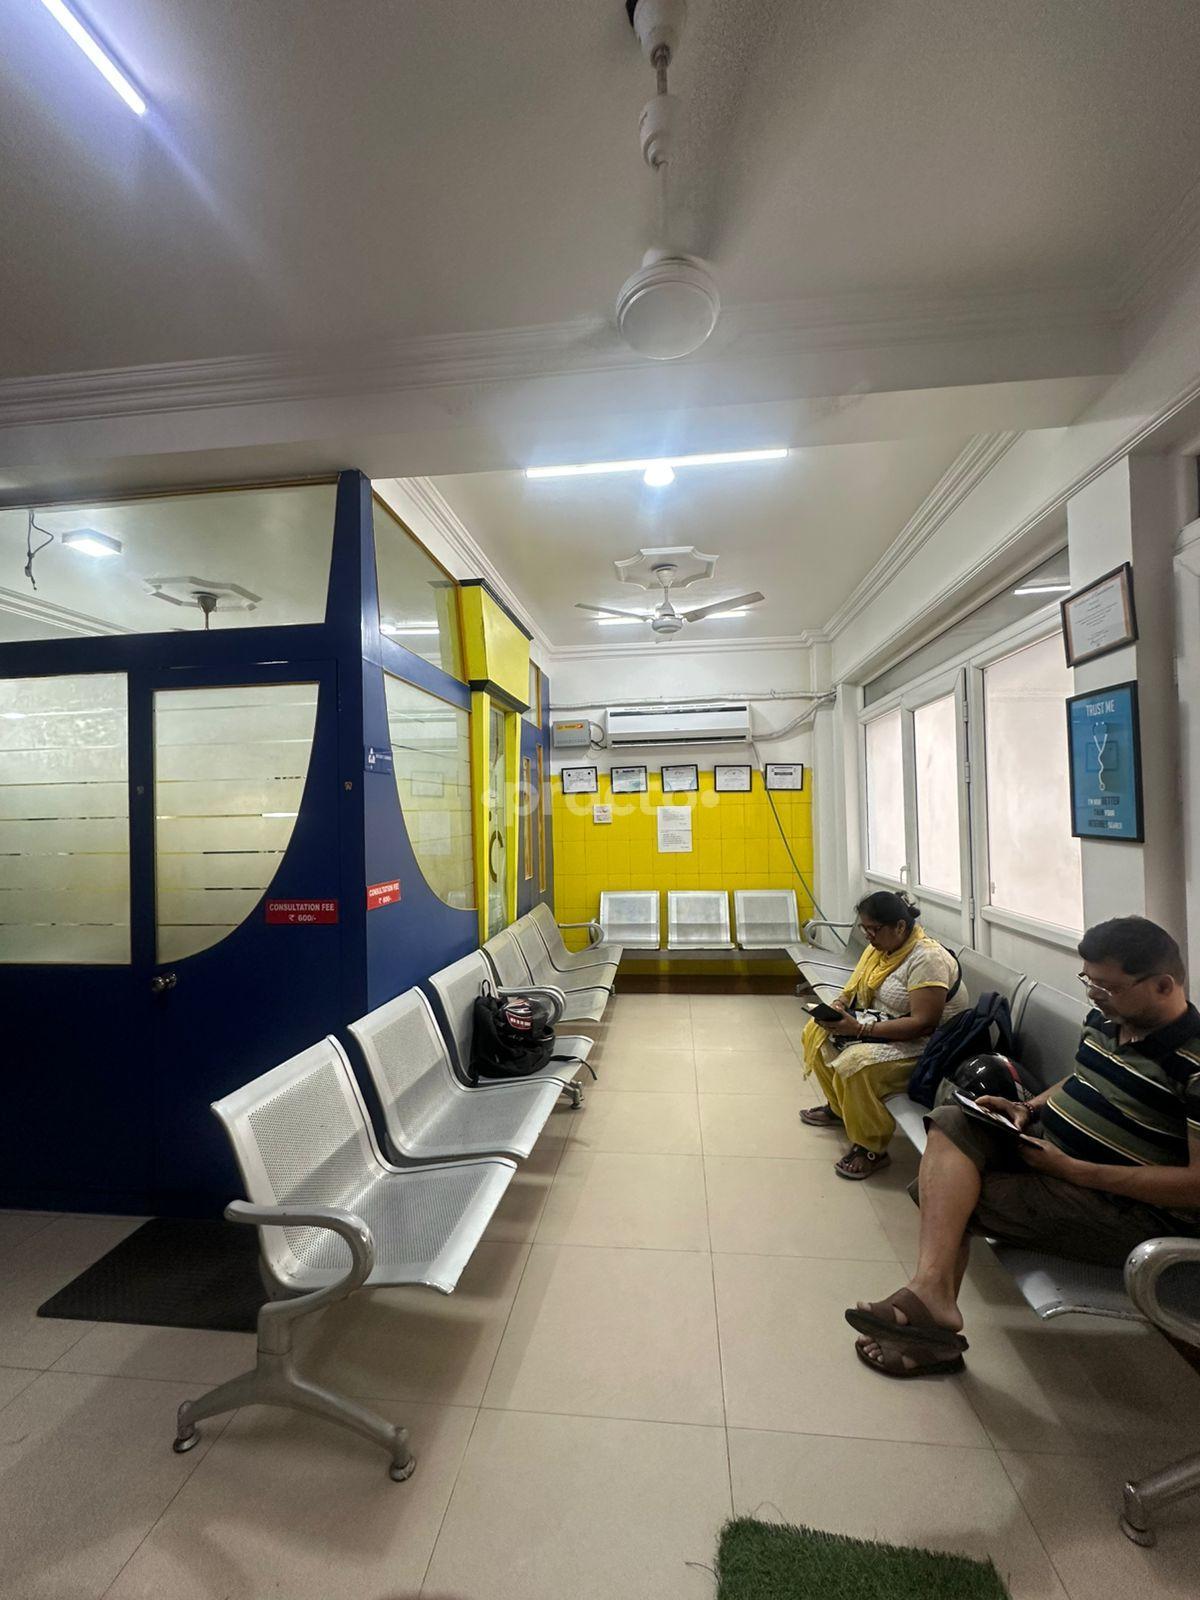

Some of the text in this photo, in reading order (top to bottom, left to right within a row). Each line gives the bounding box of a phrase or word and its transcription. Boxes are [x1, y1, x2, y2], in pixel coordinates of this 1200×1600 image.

[1086, 700, 1115, 716] TRUST ME
[269, 903, 335, 911] CONSULTATION FEE
